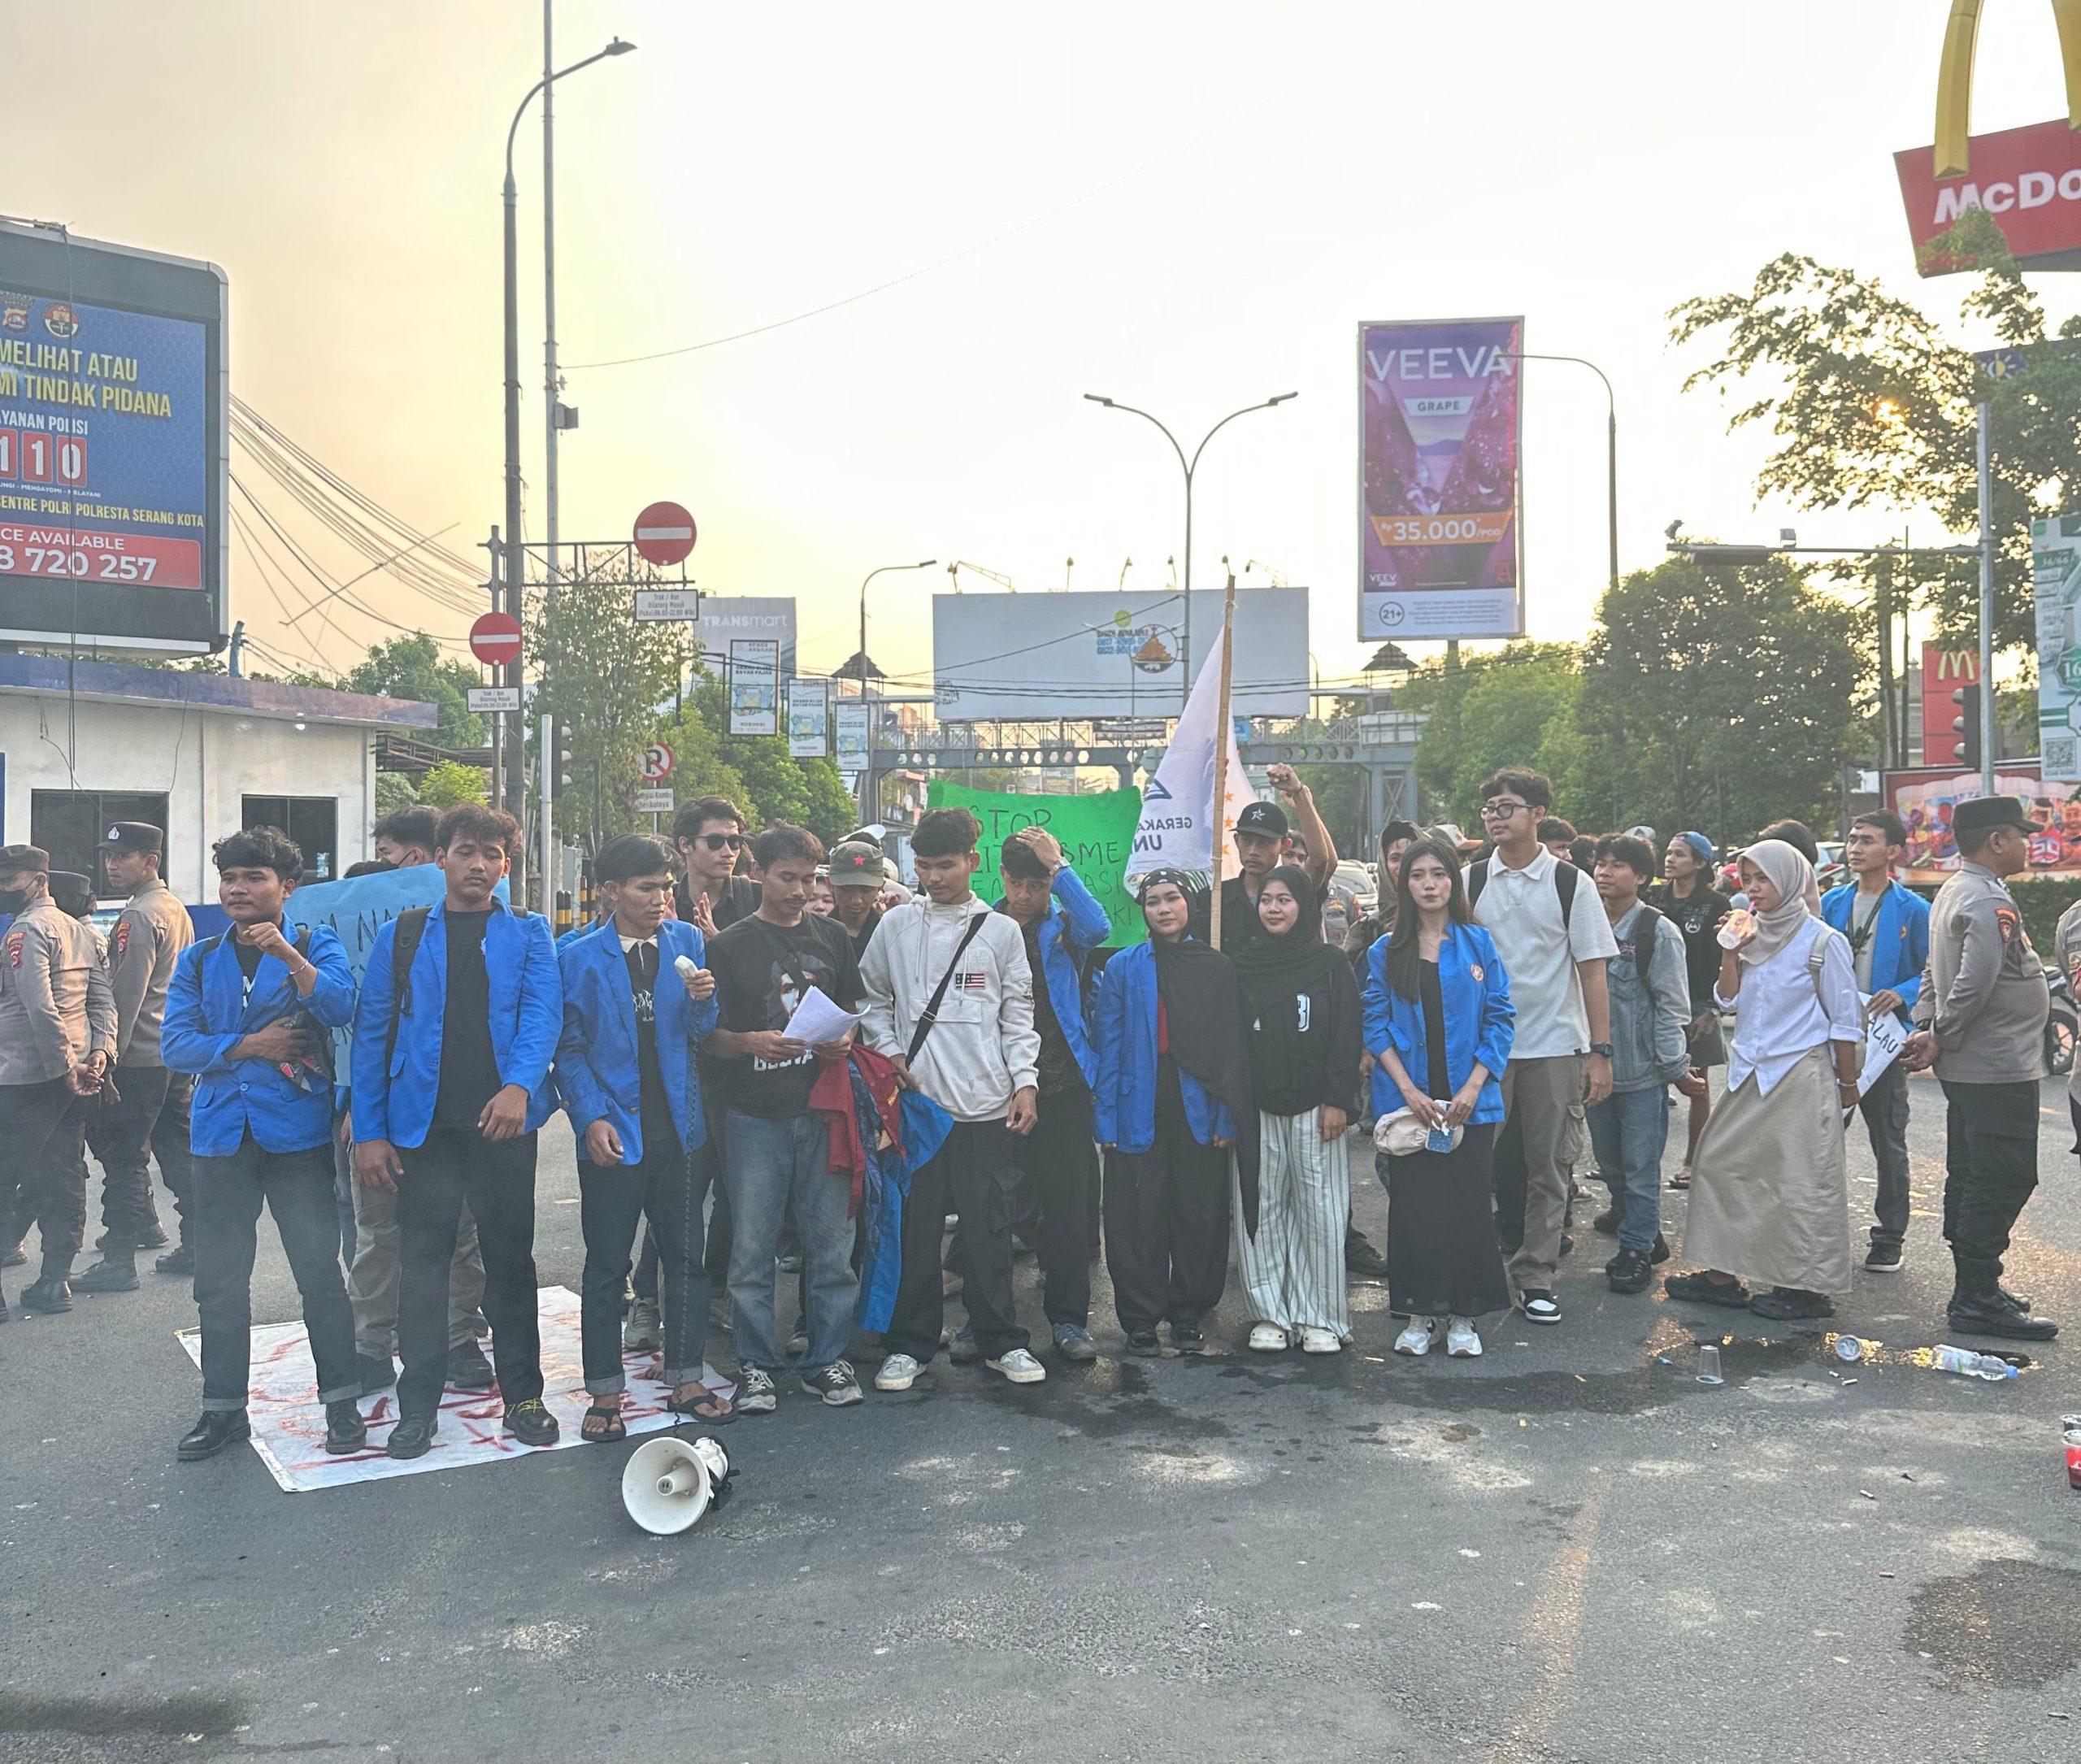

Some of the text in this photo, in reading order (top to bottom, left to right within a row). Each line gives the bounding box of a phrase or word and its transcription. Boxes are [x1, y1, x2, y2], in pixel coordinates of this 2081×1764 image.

[88, 353, 137, 382] ATAU
[1366, 345, 1512, 381] VEEVA
[24, 375, 97, 408] TINDAK
[102, 386, 172, 418] PIDANA
[1417, 400, 1461, 411] GRAPE
[0, 410, 88, 435] YANAN POLISI
[76, 503, 129, 521] POLRESTA
[133, 509, 173, 525] SERANG
[177, 513, 204, 528] KOTA
[28, 531, 124, 550] AVAILABLE
[25, 548, 89, 576] 720
[98, 554, 157, 580] 257
[1383, 610, 1401, 619] 21+
